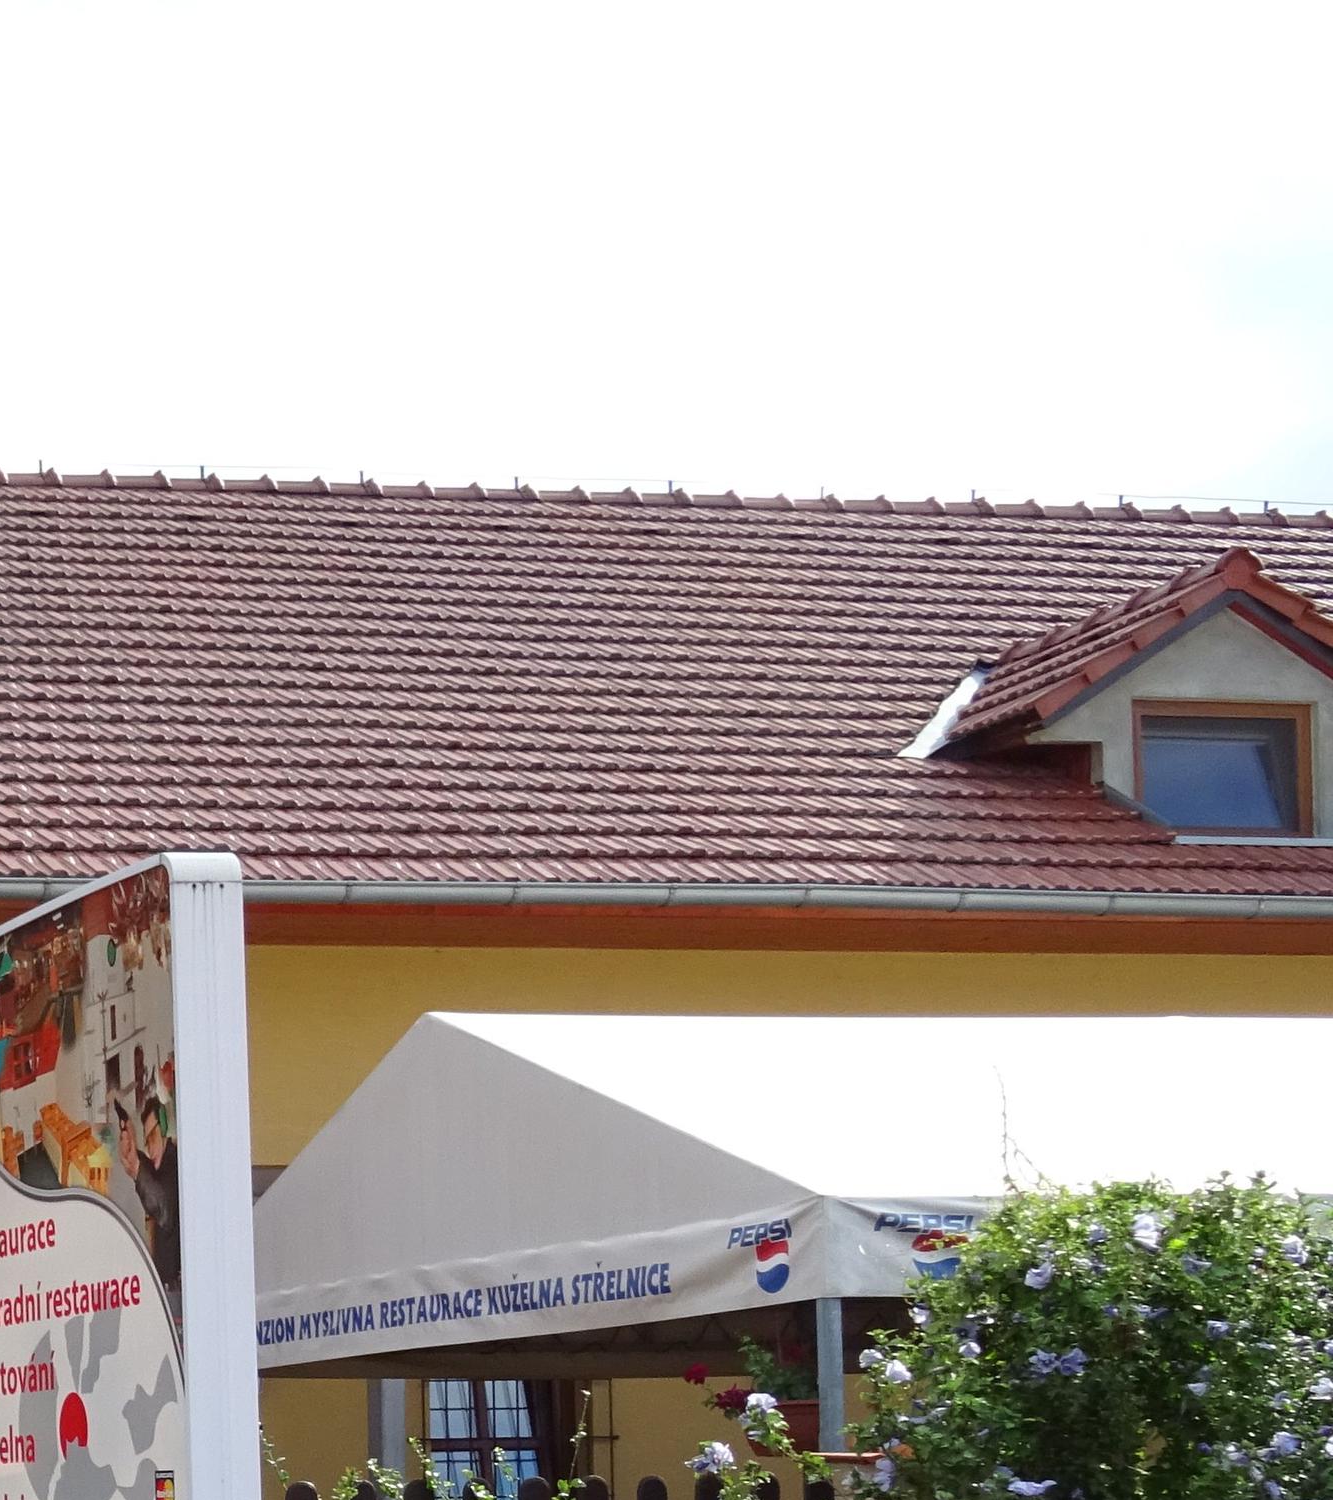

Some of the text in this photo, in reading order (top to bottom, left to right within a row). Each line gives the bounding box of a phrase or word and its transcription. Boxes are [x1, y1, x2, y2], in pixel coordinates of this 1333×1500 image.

[727, 1218, 793, 1250] PEPSI
[874, 1212, 974, 1233] PEPSI
[46, 1274, 141, 1319] restaurace
[256, 1261, 672, 1345] NZION MYSLIVNA RESTAURACE KUŽELNA STŘELNICE
